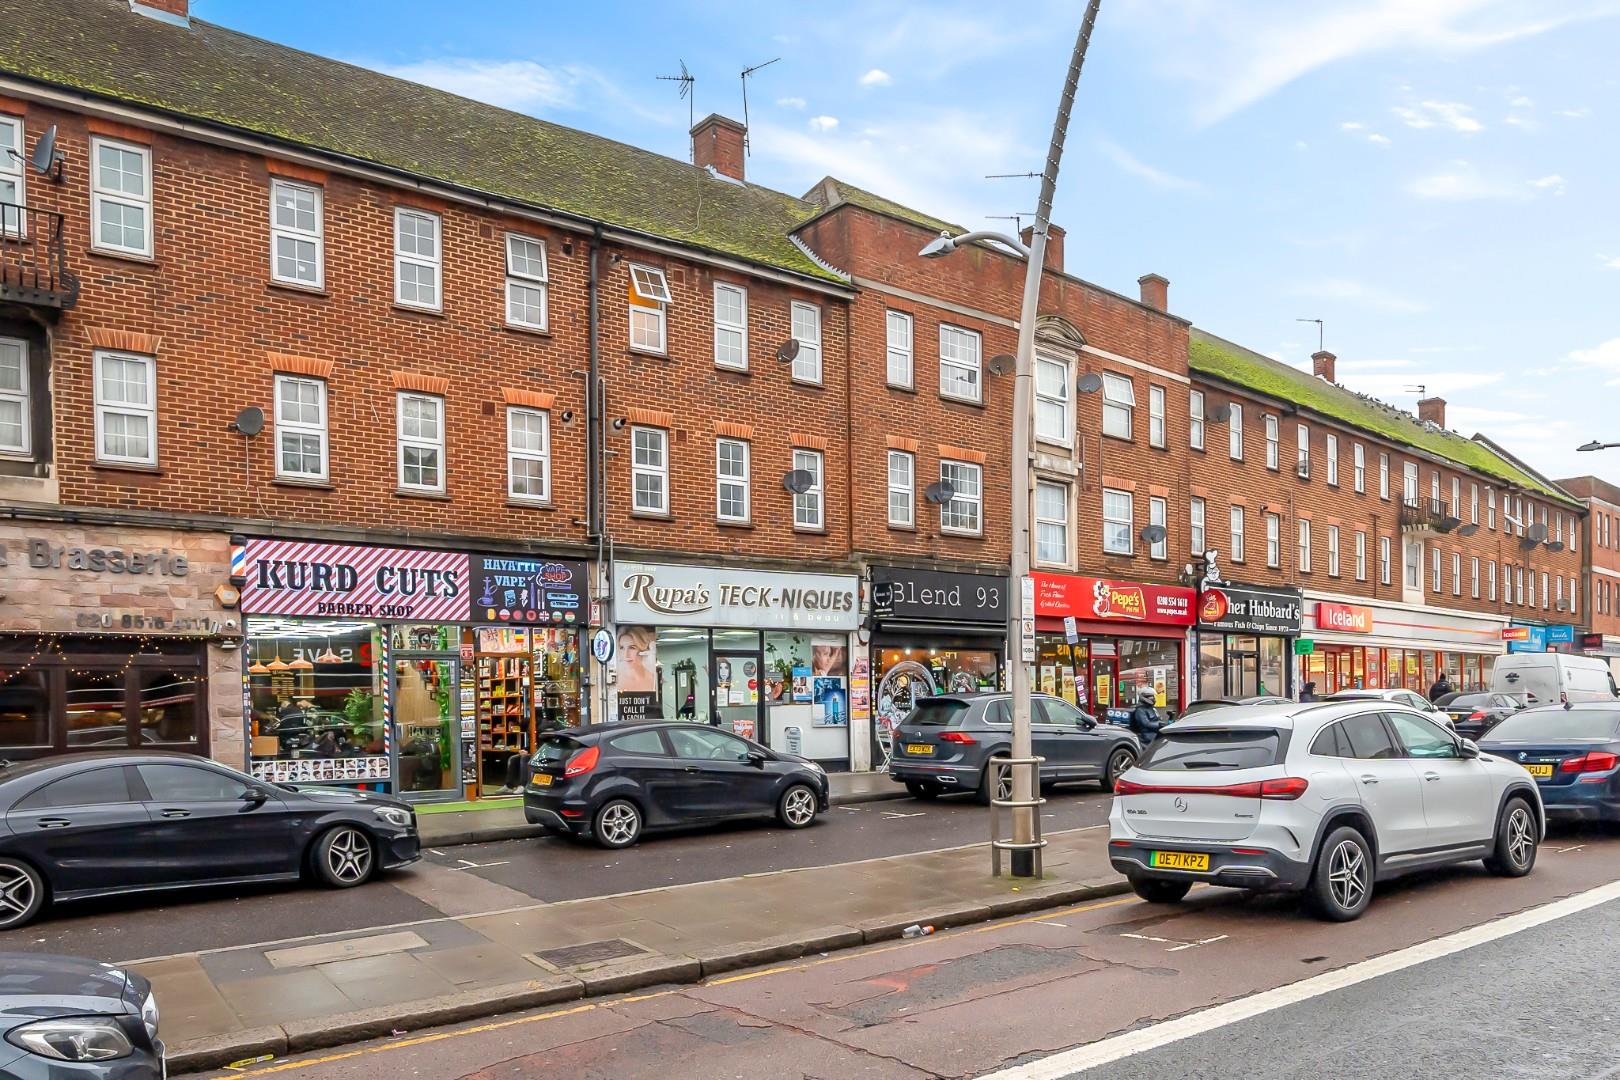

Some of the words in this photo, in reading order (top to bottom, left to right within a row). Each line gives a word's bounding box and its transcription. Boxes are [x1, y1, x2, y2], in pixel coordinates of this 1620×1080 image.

[29, 537, 188, 577] Brasserie
[544, 572, 567, 581] SHOP
[545, 566, 566, 574] VAPE
[256, 559, 358, 592] KURD
[375, 565, 460, 599] CUTS
[494, 575, 526, 587] VAPE
[623, 572, 713, 616] Rupa's
[719, 584, 853, 612] TECK-NIQUES
[894, 582, 961, 606] Blend
[976, 586, 999, 609] 93
[1111, 590, 1140, 609] Pepe's
[318, 602, 373, 615] BARBER
[379, 604, 414, 617] SHOP
[1227, 597, 1246, 614] her
[1248, 599, 1300, 620] Hubbard's
[1234, 620, 1246, 629] Fish
[1252, 622, 1265, 632] Chips
[1329, 608, 1365, 628] Iceland
[1529, 766, 1548, 775] GUJ
[1183, 855, 1205, 868] KPZ
